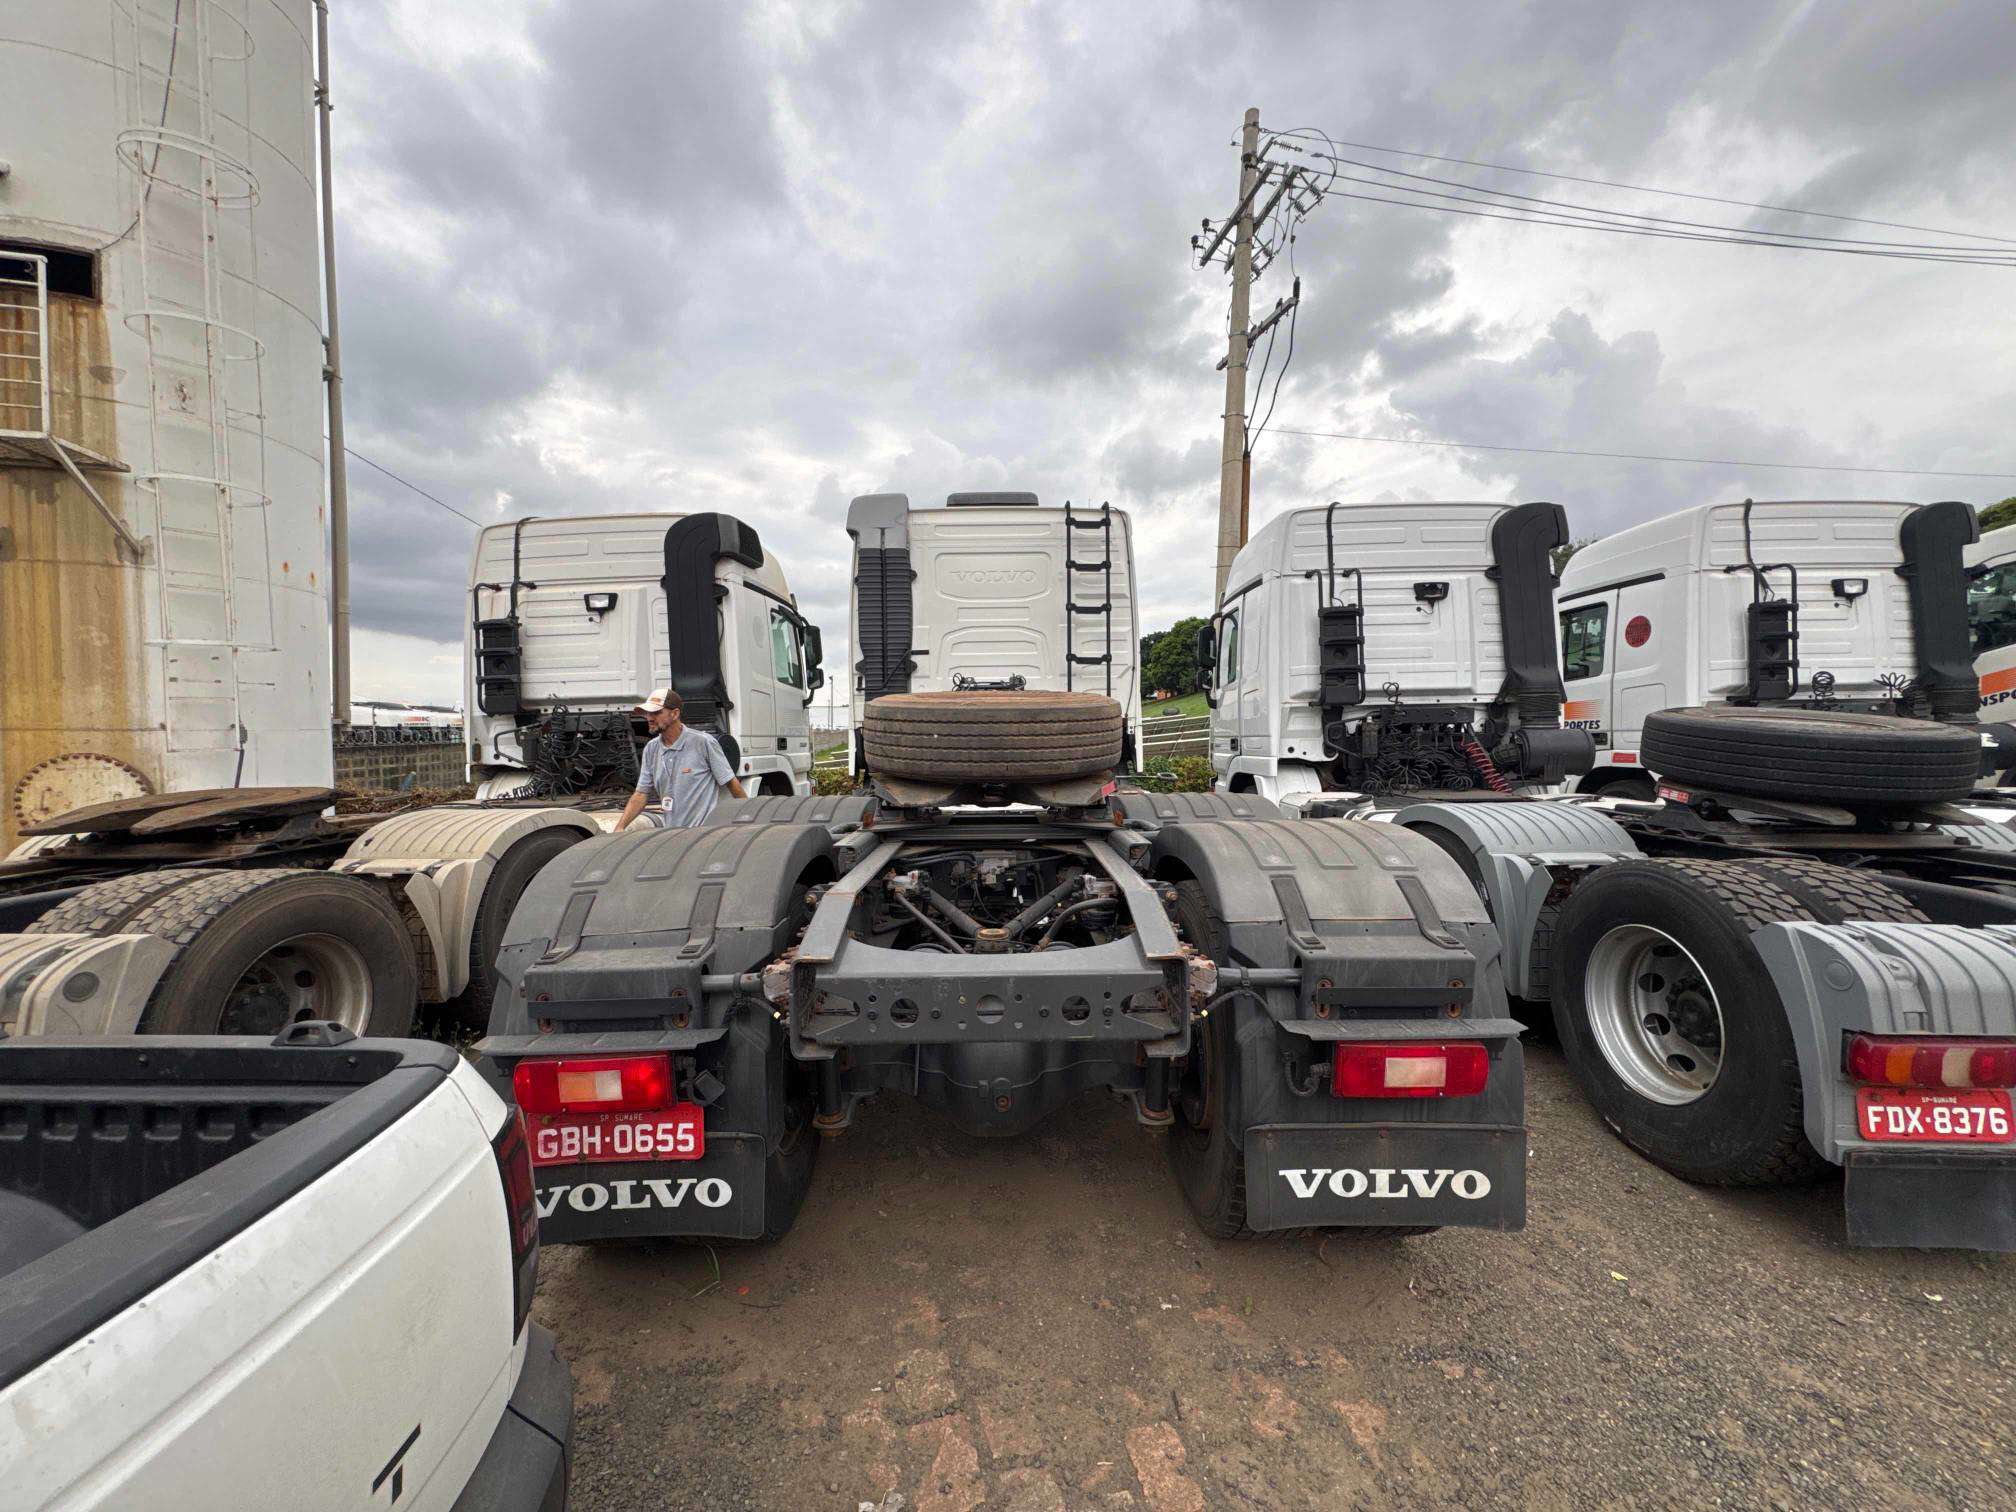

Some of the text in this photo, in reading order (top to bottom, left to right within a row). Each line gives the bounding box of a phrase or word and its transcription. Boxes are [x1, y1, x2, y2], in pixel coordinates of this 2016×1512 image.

[1564, 720, 1600, 730] PORTES
[535, 1178, 732, 1219] VOLVO
[1278, 1168, 1492, 1200] VOLVO
